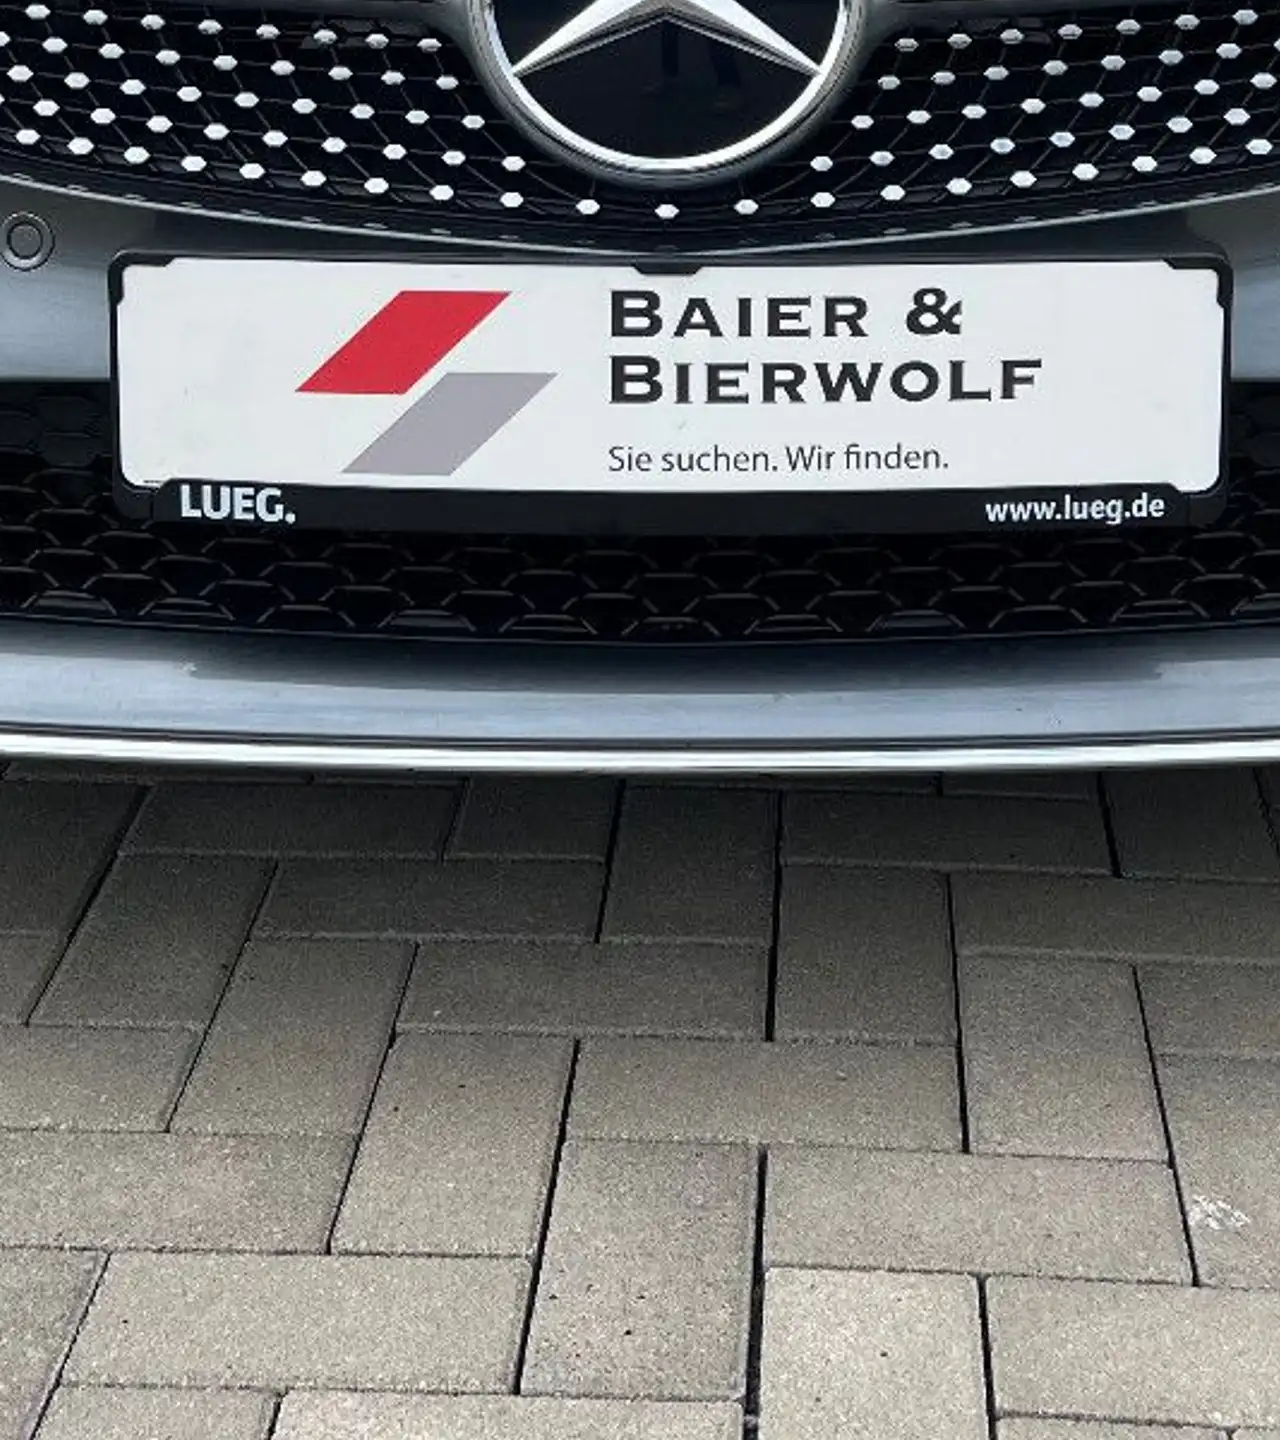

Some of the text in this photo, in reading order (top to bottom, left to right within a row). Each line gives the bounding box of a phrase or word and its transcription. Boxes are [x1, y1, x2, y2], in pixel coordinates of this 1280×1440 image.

[609, 287, 963, 338] BAIER &
[609, 355, 1042, 405] BIERWOLF
[608, 442, 949, 472] Sie suchen. Wir finden.
[180, 484, 296, 525] LUEG.
[984, 491, 1165, 525] www.lueg.de
